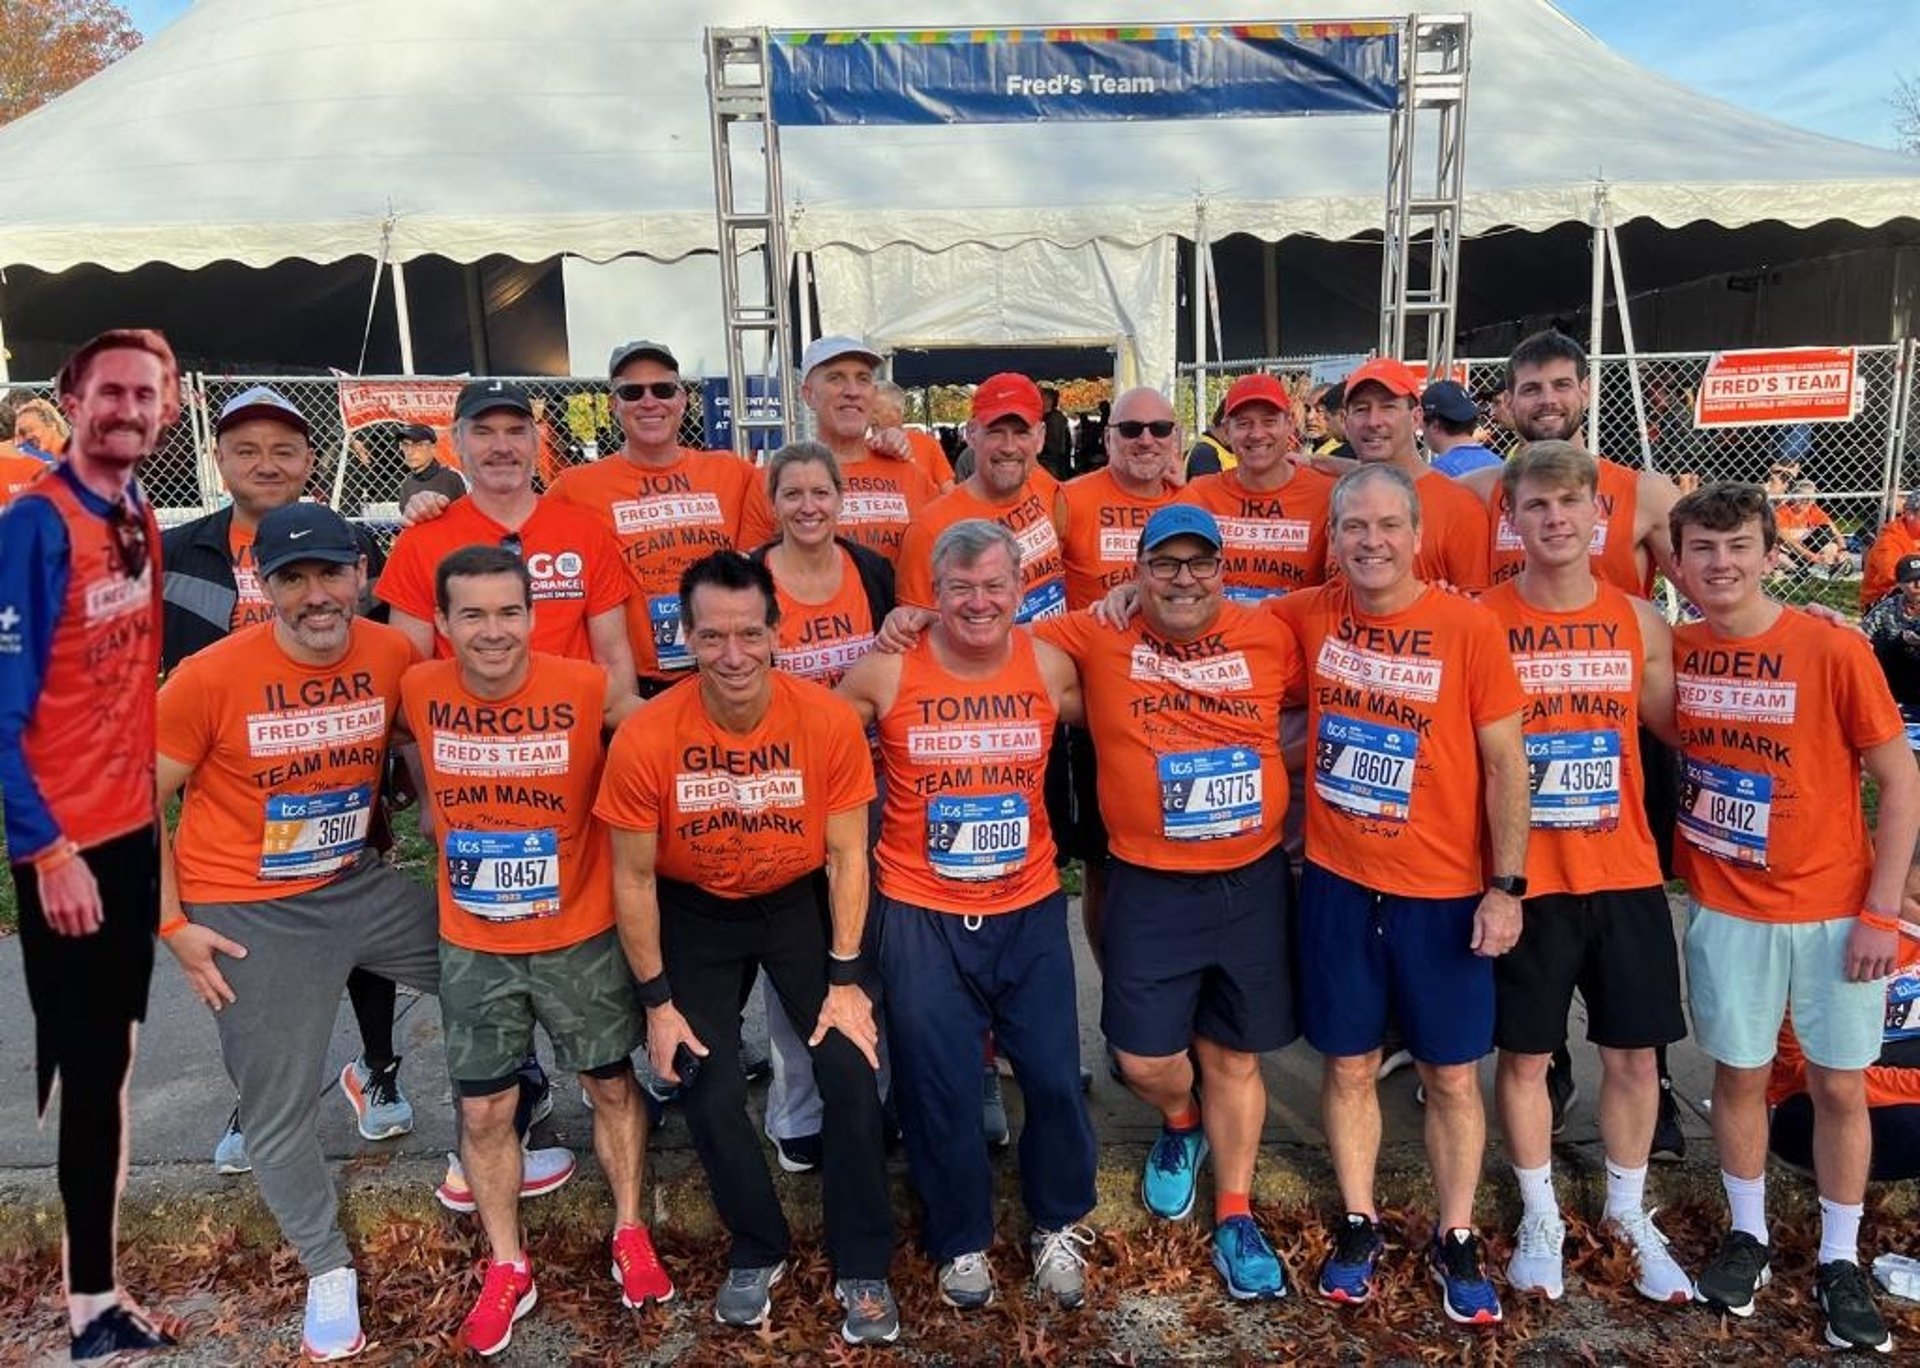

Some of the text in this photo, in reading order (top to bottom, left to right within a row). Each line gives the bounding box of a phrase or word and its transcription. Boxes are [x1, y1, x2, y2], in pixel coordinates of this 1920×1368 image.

[1006, 73, 1154, 95] Fred's Team
[350, 390, 408, 406] FRD'S
[1711, 374, 1841, 395] FRED'S TEAM
[715, 420, 729, 430] AT
[638, 472, 691, 497] JON
[842, 477, 897, 492] RSON
[619, 500, 715, 523] FRED'S TEAM
[865, 499, 902, 512] TEAM
[1100, 506, 1150, 527] STE
[1241, 498, 1284, 519] IRA
[622, 528, 732, 564] TEAM MARK
[866, 531, 901, 545] MAR
[1217, 524, 1304, 540] RED'S TEAM
[527, 552, 582, 579] GO
[1221, 557, 1247, 573] AM
[1254, 556, 1305, 582] MARK
[799, 614, 853, 644] JEN
[1337, 616, 1433, 657] STEVE
[1508, 623, 1618, 653] MATTY
[1200, 662, 1244, 681] TEAM
[1379, 664, 1433, 686] TEAM
[1517, 662, 1627, 679] RED'S TEAM
[1683, 649, 1783, 679] AIDEN
[265, 672, 374, 711] ILGAR
[1130, 691, 1262, 722] TEAM MARK
[1681, 687, 1786, 708] RED'S TEAM
[428, 700, 575, 735] MARCUS
[917, 693, 1034, 724] TOMMY
[1315, 687, 1361, 708] EAM
[1367, 692, 1433, 738] MARK
[1521, 694, 1563, 726] EAM
[257, 719, 327, 741] FRED'S
[335, 708, 381, 731] TEAM
[438, 743, 562, 762] FRED'S TEAM
[914, 731, 1036, 752] FRED'S TEAM
[1680, 726, 1792, 768] EAM MARK
[252, 753, 322, 790] TEAM
[682, 741, 791, 776] GLENN
[1351, 750, 1406, 788] 18607
[914, 766, 1036, 797] TEAM MARK
[1205, 773, 1255, 808] 43775
[1560, 759, 1613, 792] 43629
[282, 802, 307, 817] tcs
[434, 784, 567, 813] TEAM MARK
[938, 802, 961, 818] tcs
[1711, 795, 1756, 832] 18412
[318, 814, 358, 846] 36111
[676, 811, 805, 841] TEAM MARK
[972, 820, 1022, 852] 18608
[494, 859, 548, 889] 18457
